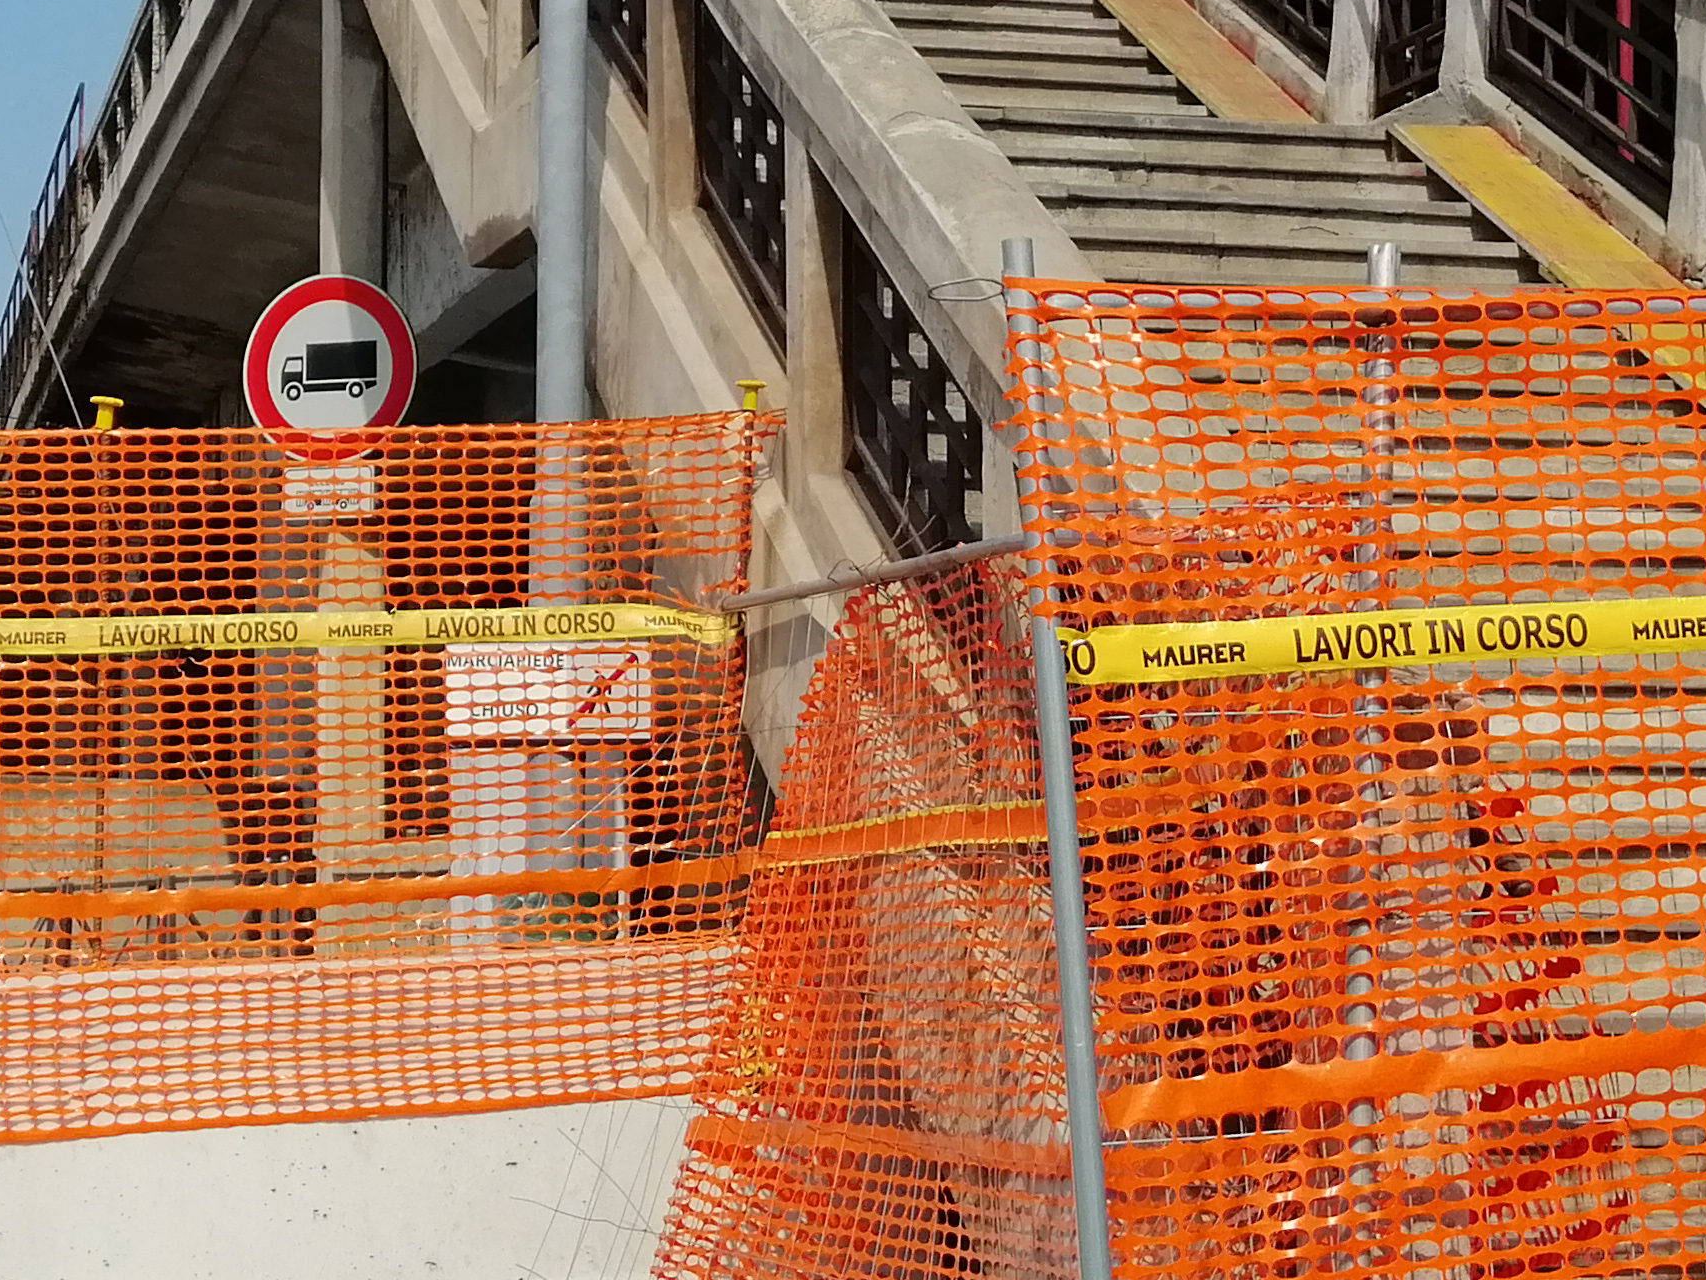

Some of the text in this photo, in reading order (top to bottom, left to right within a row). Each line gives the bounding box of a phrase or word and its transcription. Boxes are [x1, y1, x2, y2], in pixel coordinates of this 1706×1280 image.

[99, 622, 182, 648] LAVORI
[192, 622, 215, 644] IN
[222, 620, 298, 644] CORSO
[328, 624, 394, 638] MAURER
[425, 615, 505, 638] LAVORI
[512, 614, 536, 636] IN
[544, 611, 615, 635] CORSO
[644, 615, 704, 635] MAURER
[1143, 642, 1246, 668] MAURER
[1293, 621, 1416, 663] LAVORI
[1424, 618, 1465, 654] IN
[1477, 613, 1588, 652] CORSO
[471, 703, 540, 717] CHUSO
